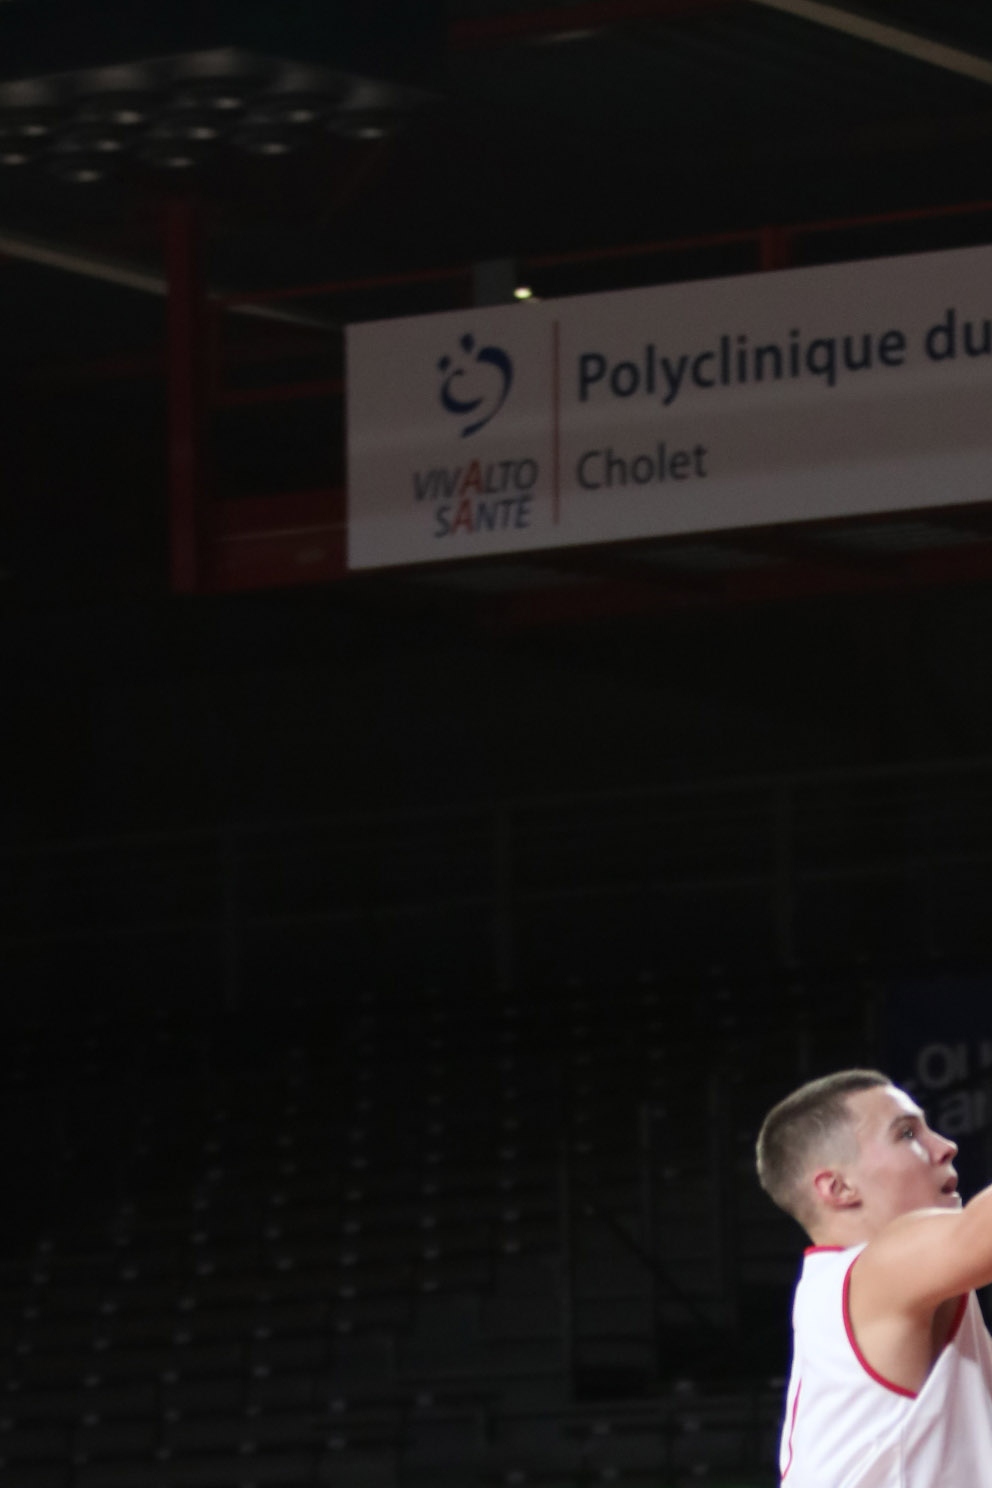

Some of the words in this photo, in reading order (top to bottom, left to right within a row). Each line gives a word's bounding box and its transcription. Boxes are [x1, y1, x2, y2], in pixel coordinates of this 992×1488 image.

[578, 329, 907, 406] Polyclinique
[924, 309, 992, 362] du
[412, 459, 539, 501] VIVALTO
[576, 444, 708, 489] Cholet
